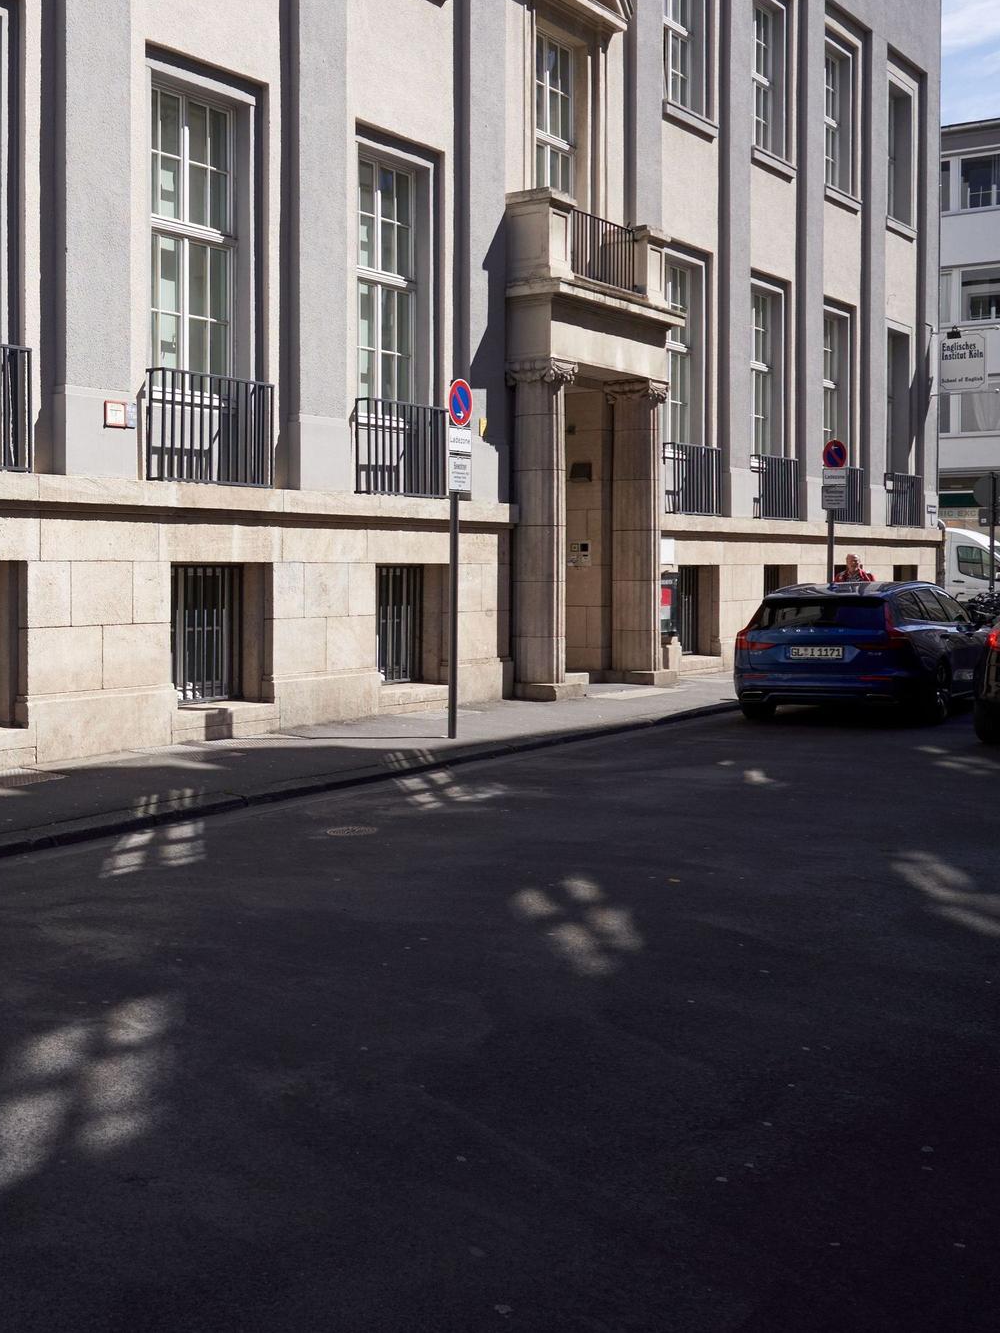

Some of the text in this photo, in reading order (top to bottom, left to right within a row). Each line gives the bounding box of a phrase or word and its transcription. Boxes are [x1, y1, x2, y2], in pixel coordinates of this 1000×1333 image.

[942, 342, 976, 352] Englisches
[942, 350, 983, 360] Institut Köln
[791, 648, 803, 656] GL
[818, 648, 841, 657] 1171
